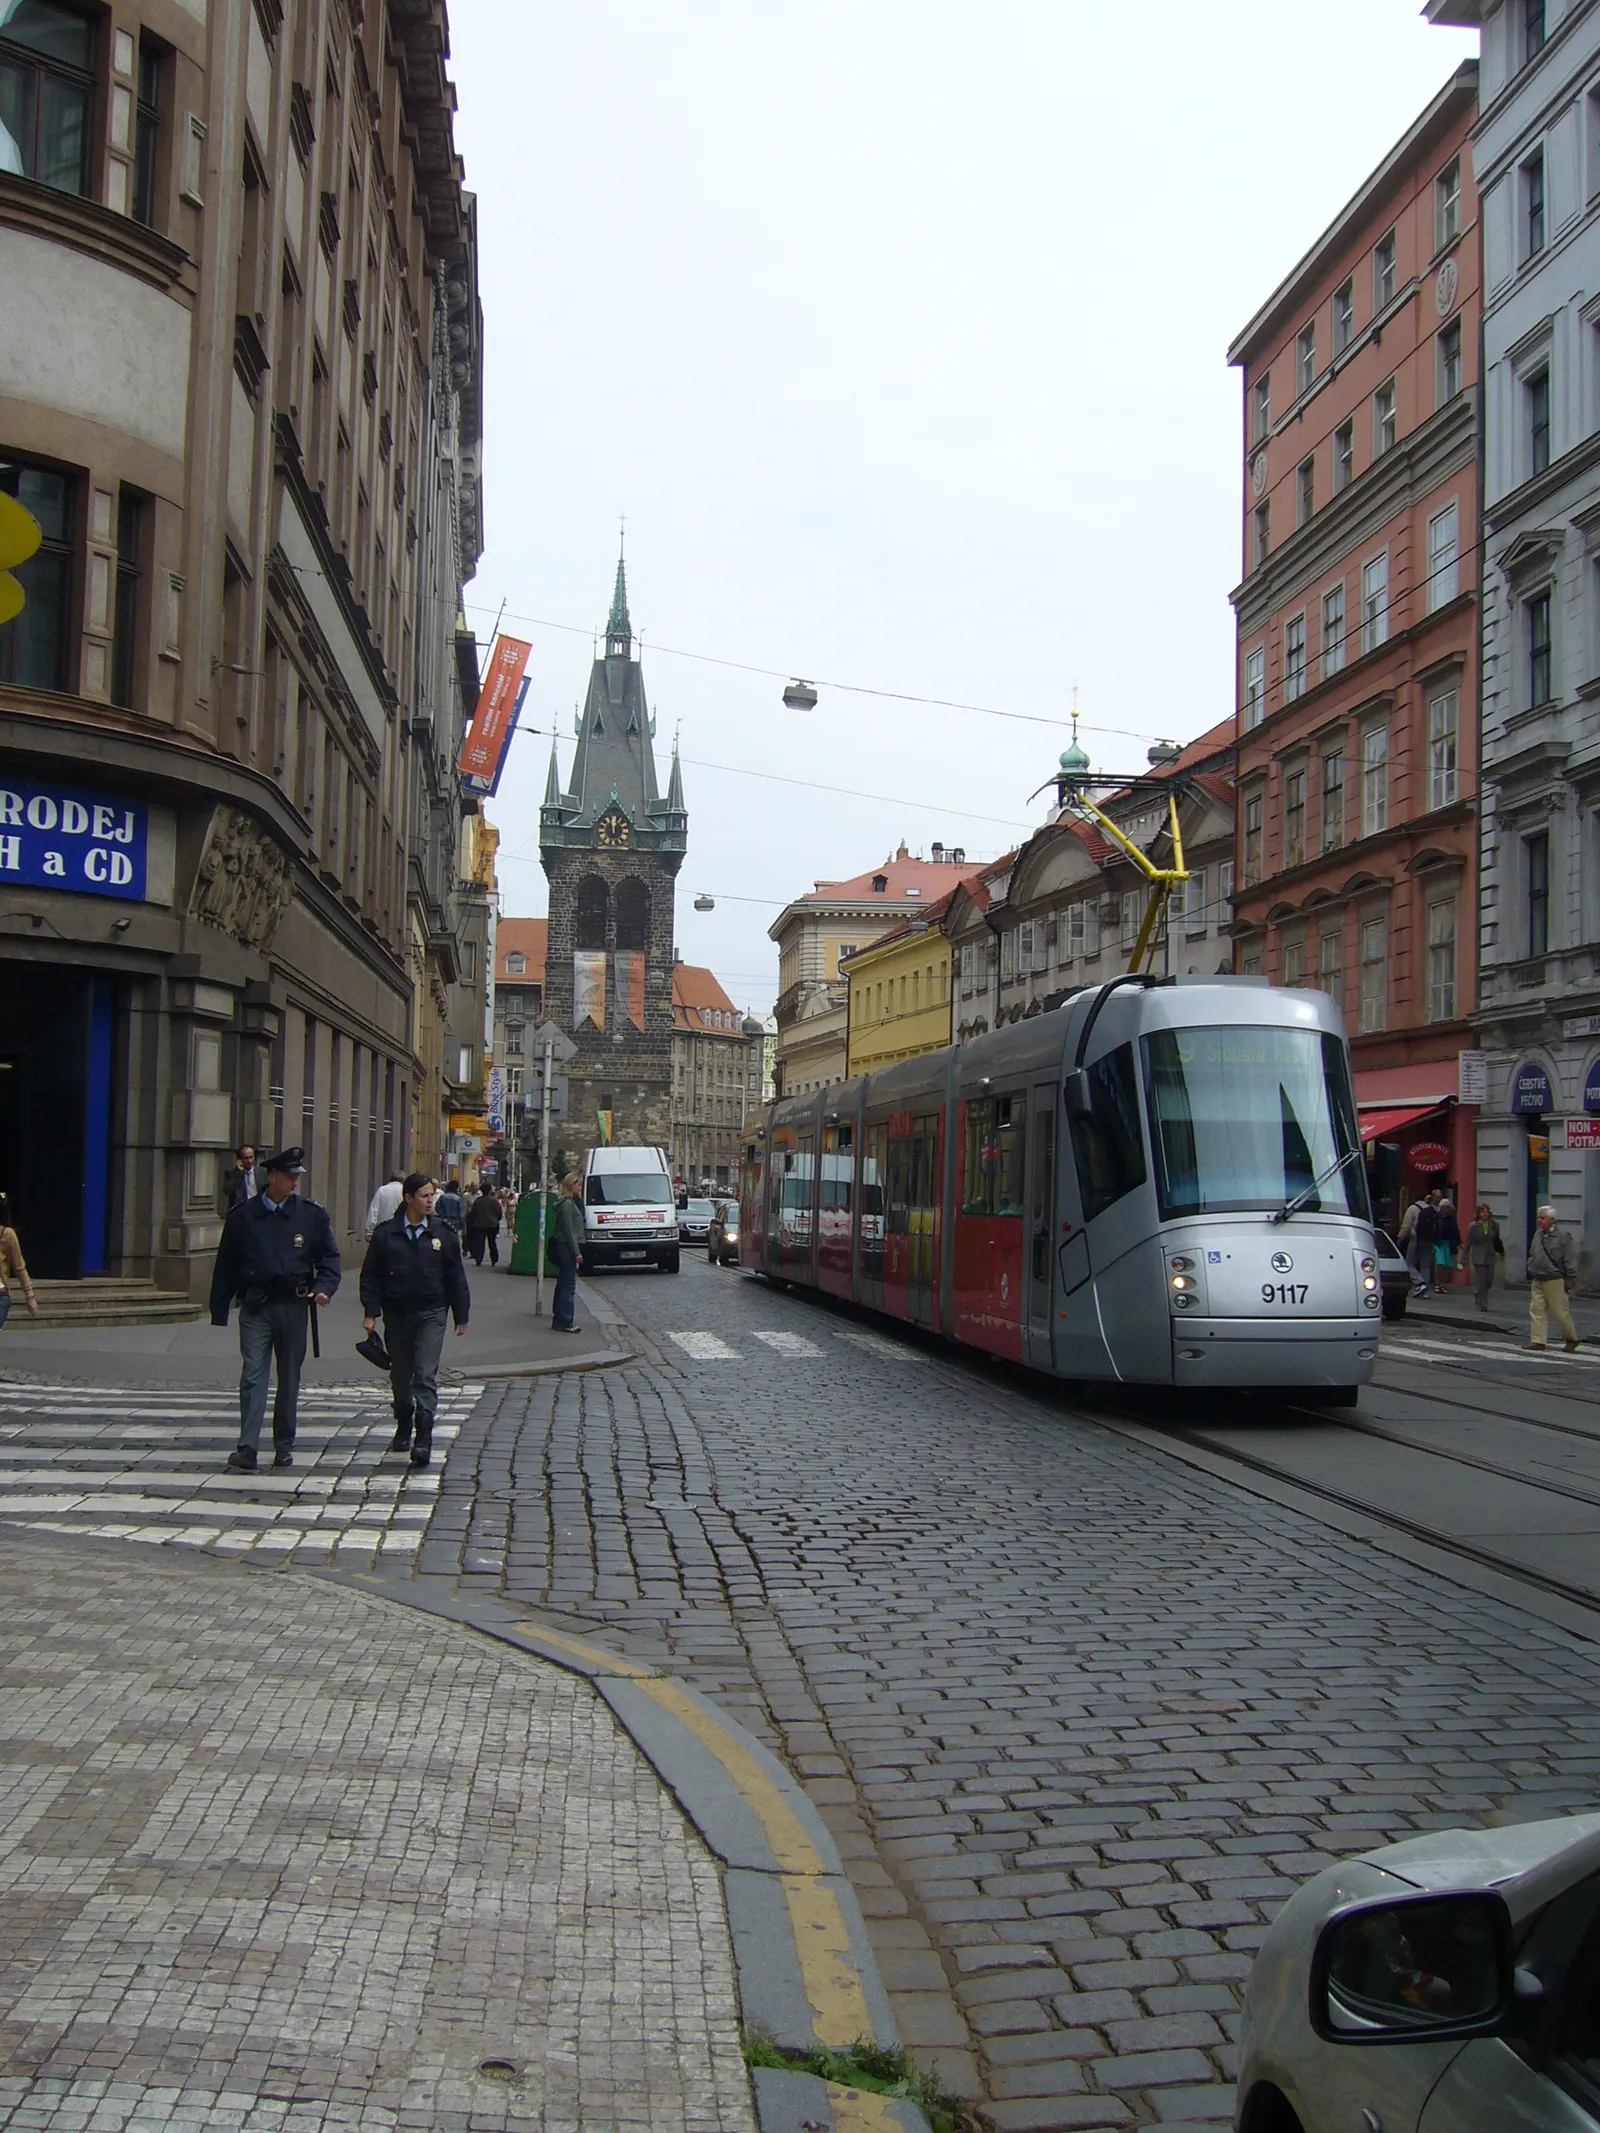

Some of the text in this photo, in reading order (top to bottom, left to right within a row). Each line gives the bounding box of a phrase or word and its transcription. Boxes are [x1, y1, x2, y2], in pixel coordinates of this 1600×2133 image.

[0, 789, 135, 844] RODEJ
[42, 851, 66, 876] a
[84, 848, 133, 885] CD
[1519, 1075, 1547, 1090] ČERSTVÉ
[489, 1068, 501, 1114] Blue Style
[1520, 1092, 1544, 1107] PEČIVO
[1568, 1121, 1591, 1133] NON
[1409, 1142, 1449, 1156] RISTORANTE
[1414, 1161, 1447, 1172] PIZZERIA
[1261, 1283, 1309, 1304] 9117
